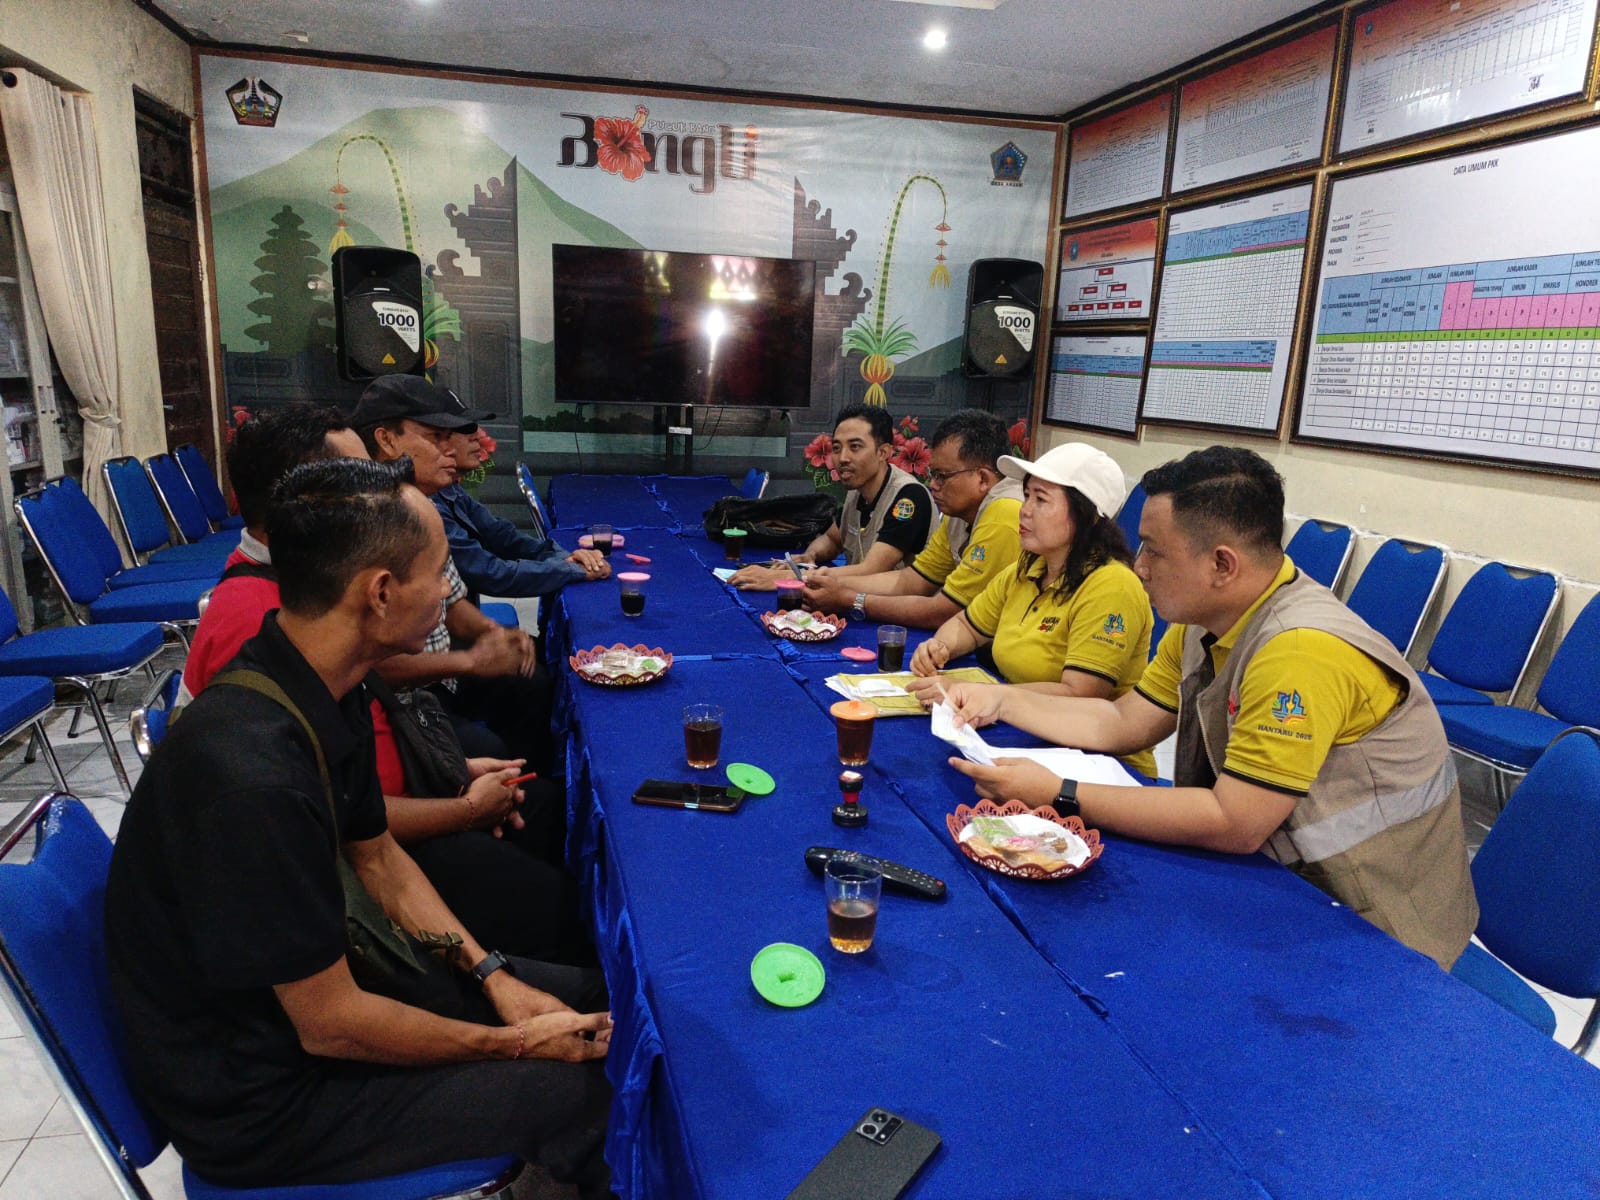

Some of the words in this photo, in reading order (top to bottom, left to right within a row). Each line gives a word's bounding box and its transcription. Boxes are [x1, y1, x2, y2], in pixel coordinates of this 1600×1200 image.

[557, 111, 757, 194] Bngli
[1454, 165, 1466, 175] DATA
[1468, 161, 1487, 172] UMUM
[379, 313, 415, 327] 1000
[999, 316, 1031, 328] 1000
[1257, 724, 1293, 737] HANTARU
